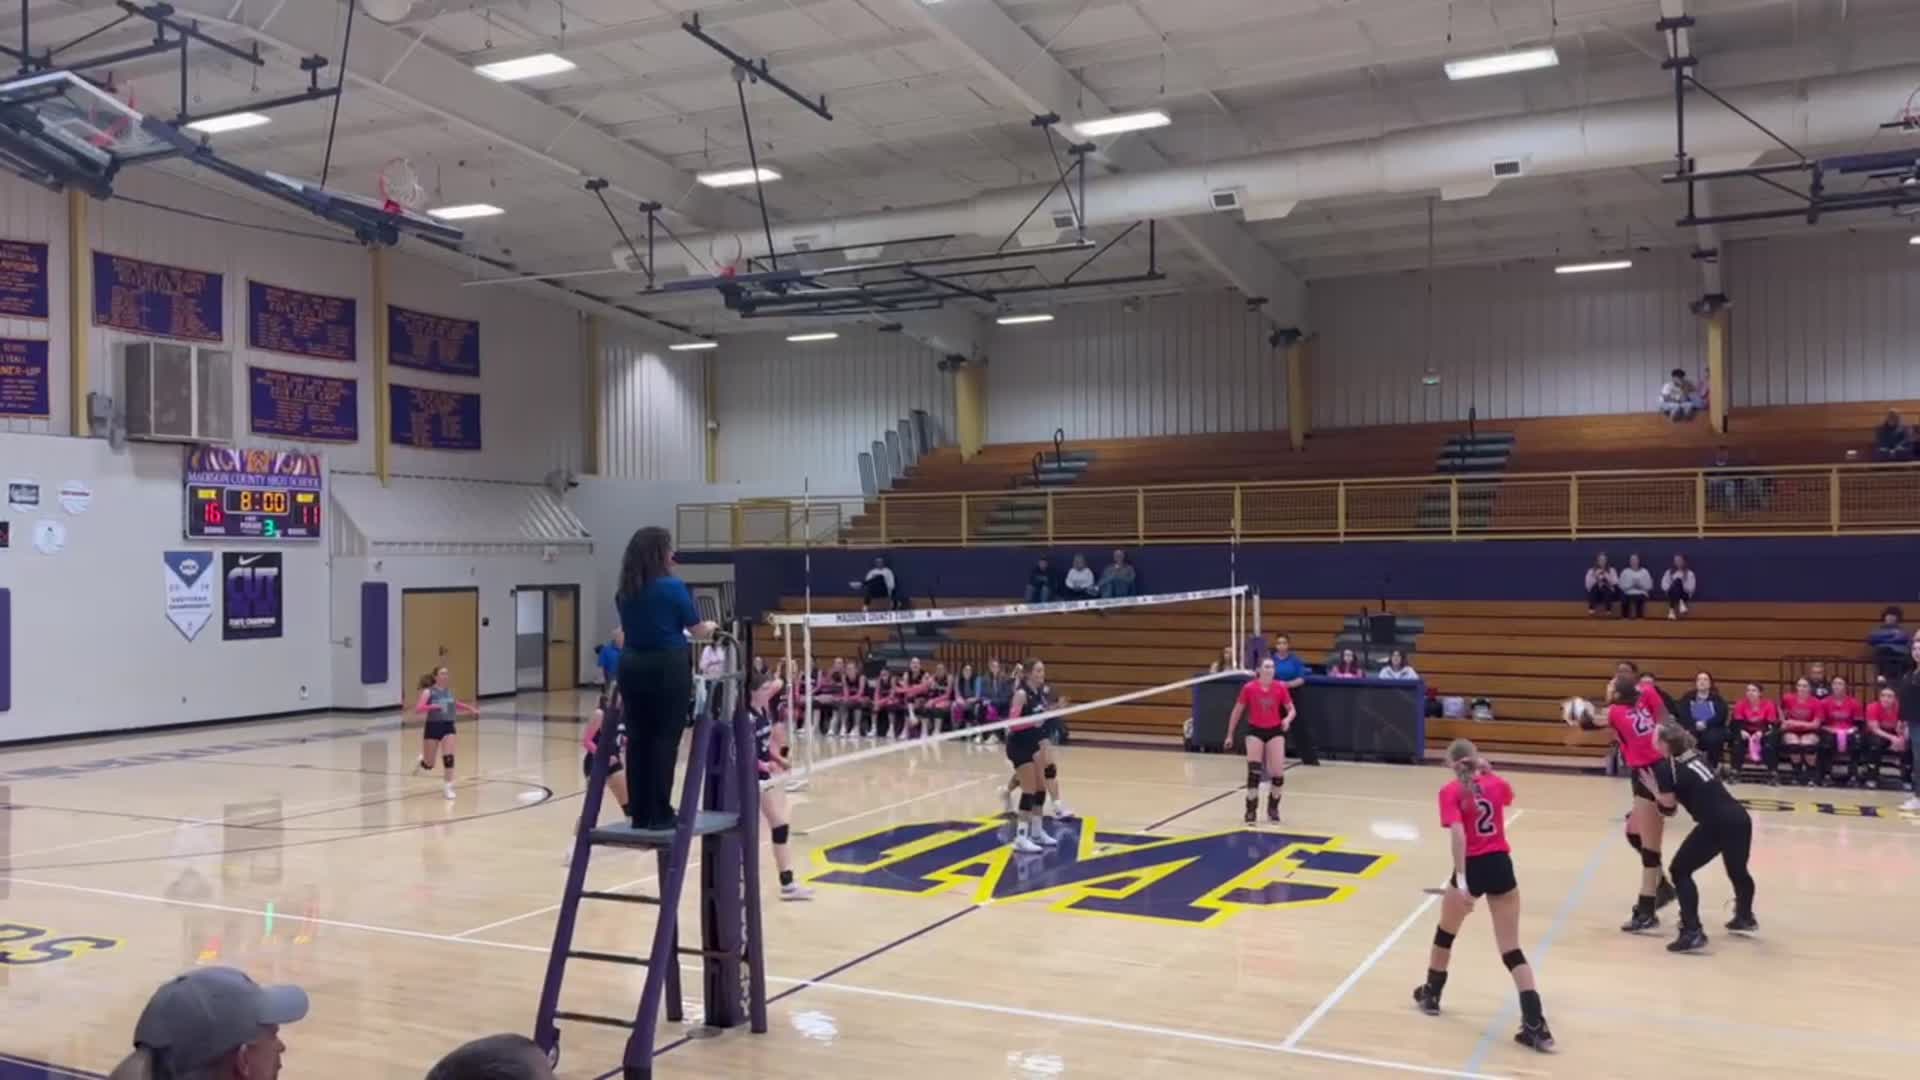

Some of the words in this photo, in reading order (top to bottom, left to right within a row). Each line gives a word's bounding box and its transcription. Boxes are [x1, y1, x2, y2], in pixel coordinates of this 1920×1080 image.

[231, 475, 265, 485] COUNTY
[204, 502, 222, 524] 16
[240, 491, 285, 513] 8:00
[303, 505, 320, 527] 11
[263, 519, 275, 536] 3
[1475, 798, 1497, 836] 2
